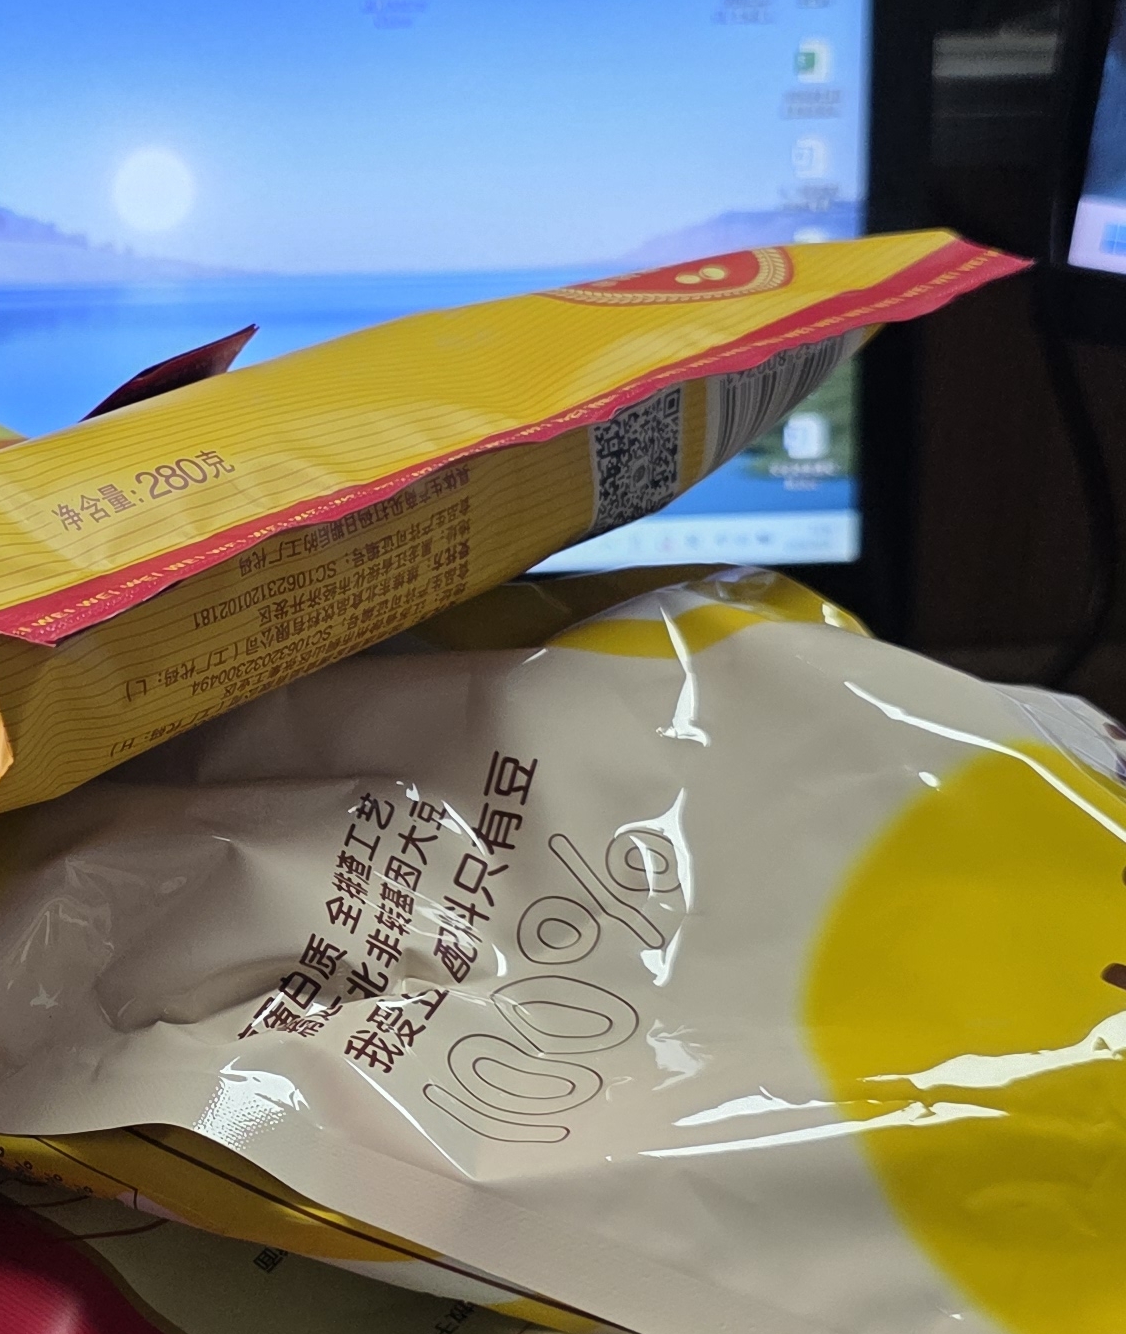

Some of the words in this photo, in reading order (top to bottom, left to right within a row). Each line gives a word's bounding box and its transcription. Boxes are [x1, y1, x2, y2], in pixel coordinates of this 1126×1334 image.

[325, 793, 395, 934] 全排渣工艺
